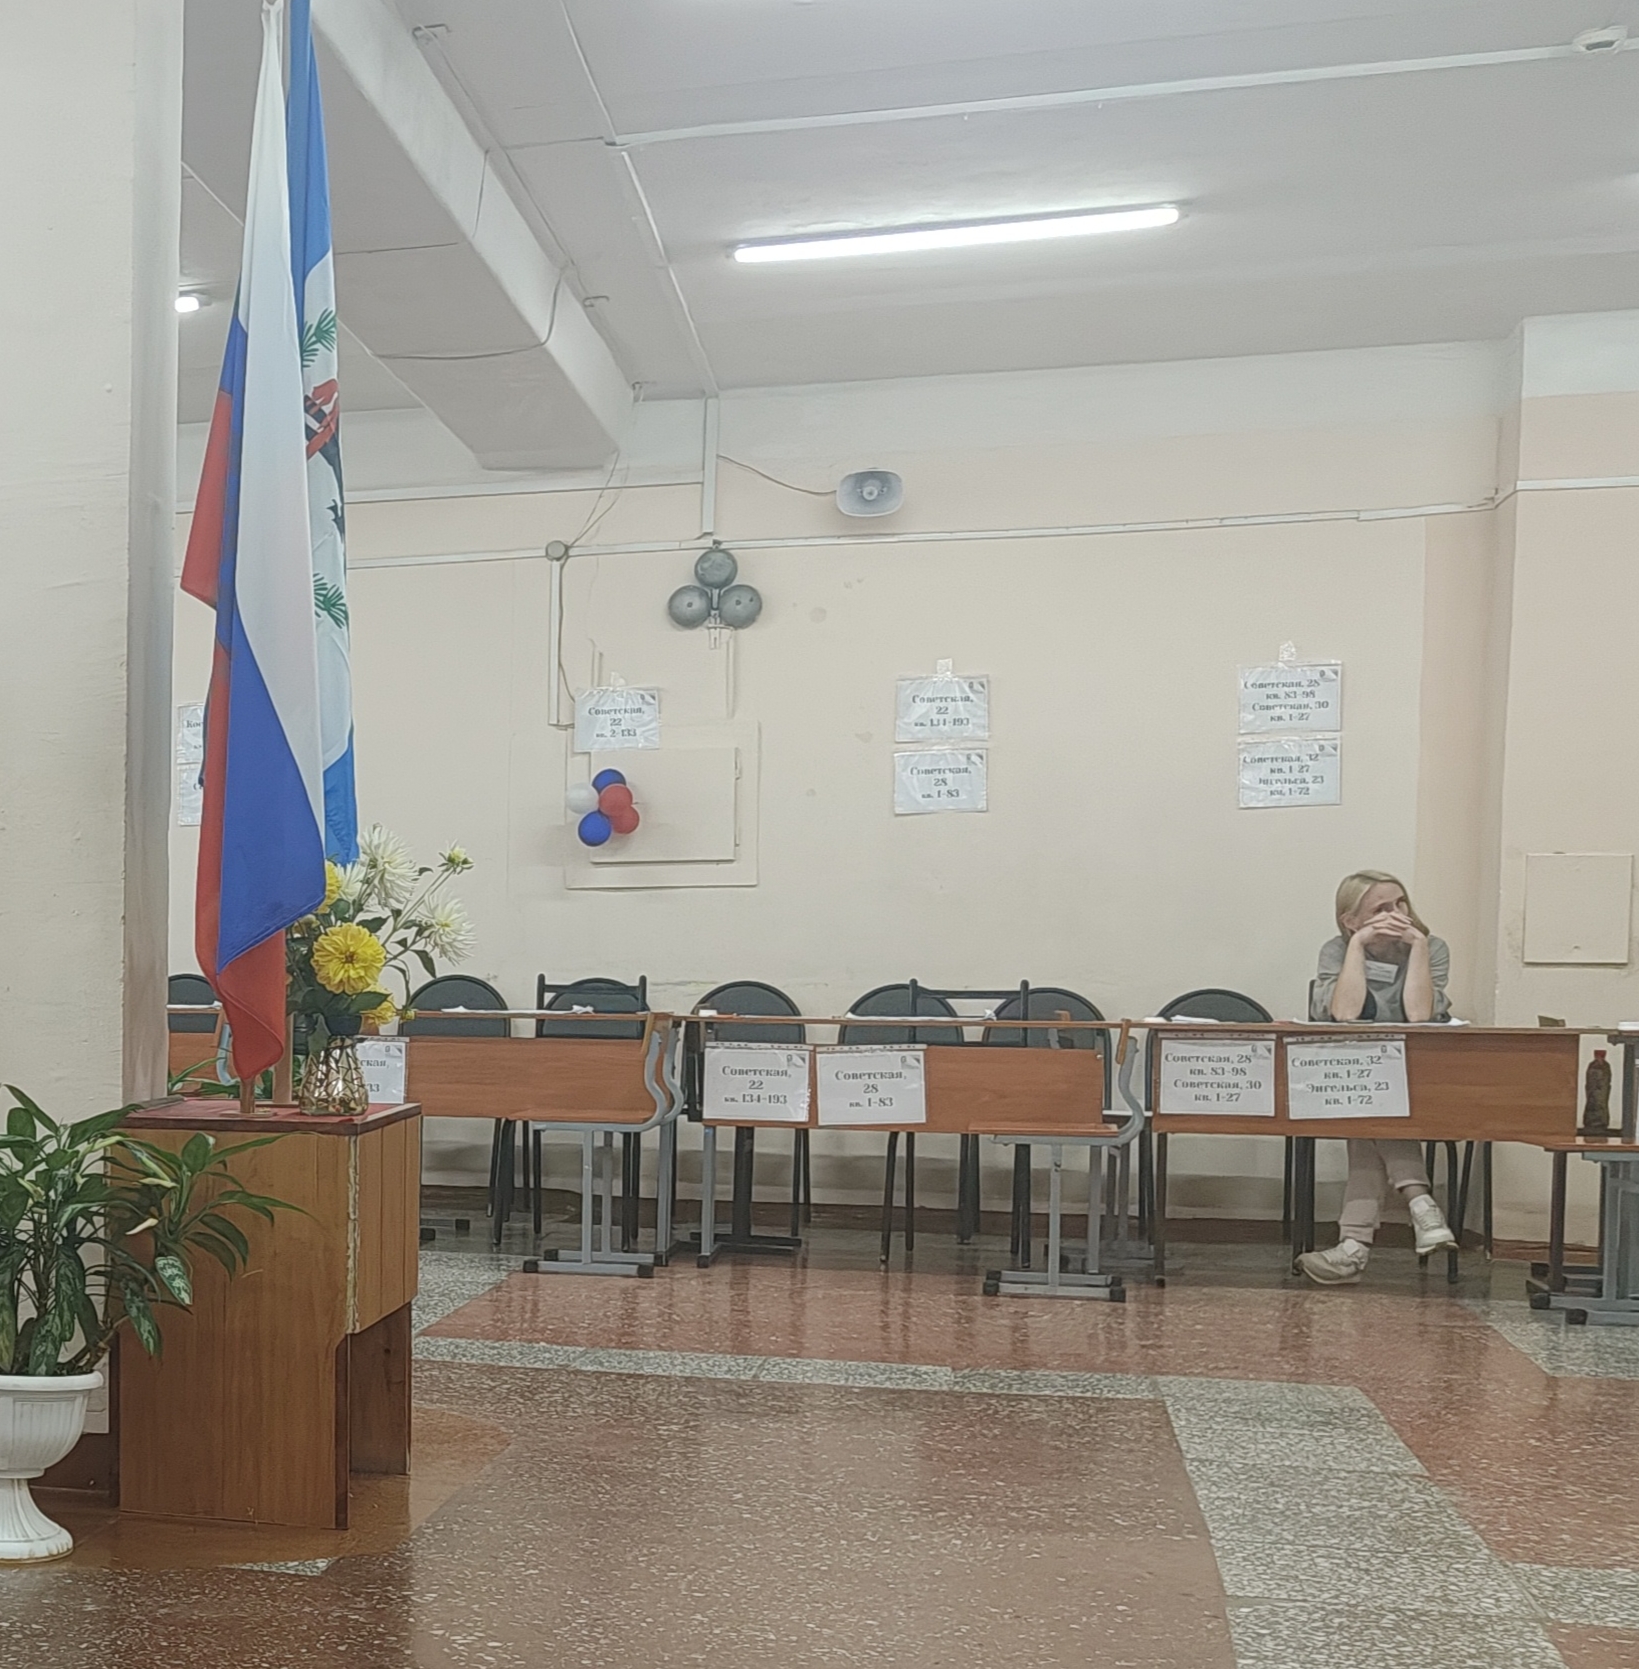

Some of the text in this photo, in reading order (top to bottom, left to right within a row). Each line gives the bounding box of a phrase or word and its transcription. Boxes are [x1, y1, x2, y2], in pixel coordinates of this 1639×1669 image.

[1306, 679, 1321, 688] 28
[1284, 690, 1316, 699] 83-98
[1315, 700, 1330, 709] 30
[588, 707, 645, 716] Советская,
[935, 706, 949, 715] 22
[1289, 712, 1311, 721] 1-27
[610, 718, 622, 726] 22
[910, 766, 972, 776] Советская,
[933, 778, 948, 787] 28
[937, 789, 959, 798] 1-83
[1289, 787, 1310, 796] 1-72
[1165, 1053, 1252, 1064] Советская, 28
[1291, 1055, 1383, 1069] Советская, 32
[360, 1060, 390, 1069] ская,
[722, 1065, 792, 1078] Советская,
[835, 1069, 907, 1081] Советская,
[1189, 1066, 1248, 1077] кв. 83-98
[1324, 1069, 1373, 1081] кв. 1-27
[748, 1080, 764, 1090] 22
[863, 1083, 879, 1094] 28
[1173, 1079, 1262, 1090] Советская, 30
[1307, 1082, 1390, 1093] Энгельса, 23
[742, 1093, 788, 1104] 134-193
[849, 1096, 894, 1108] кв. 1-83
[1194, 1092, 1242, 1103] кв. 1-27
[1325, 1095, 1374, 1106] кв. 1-72
